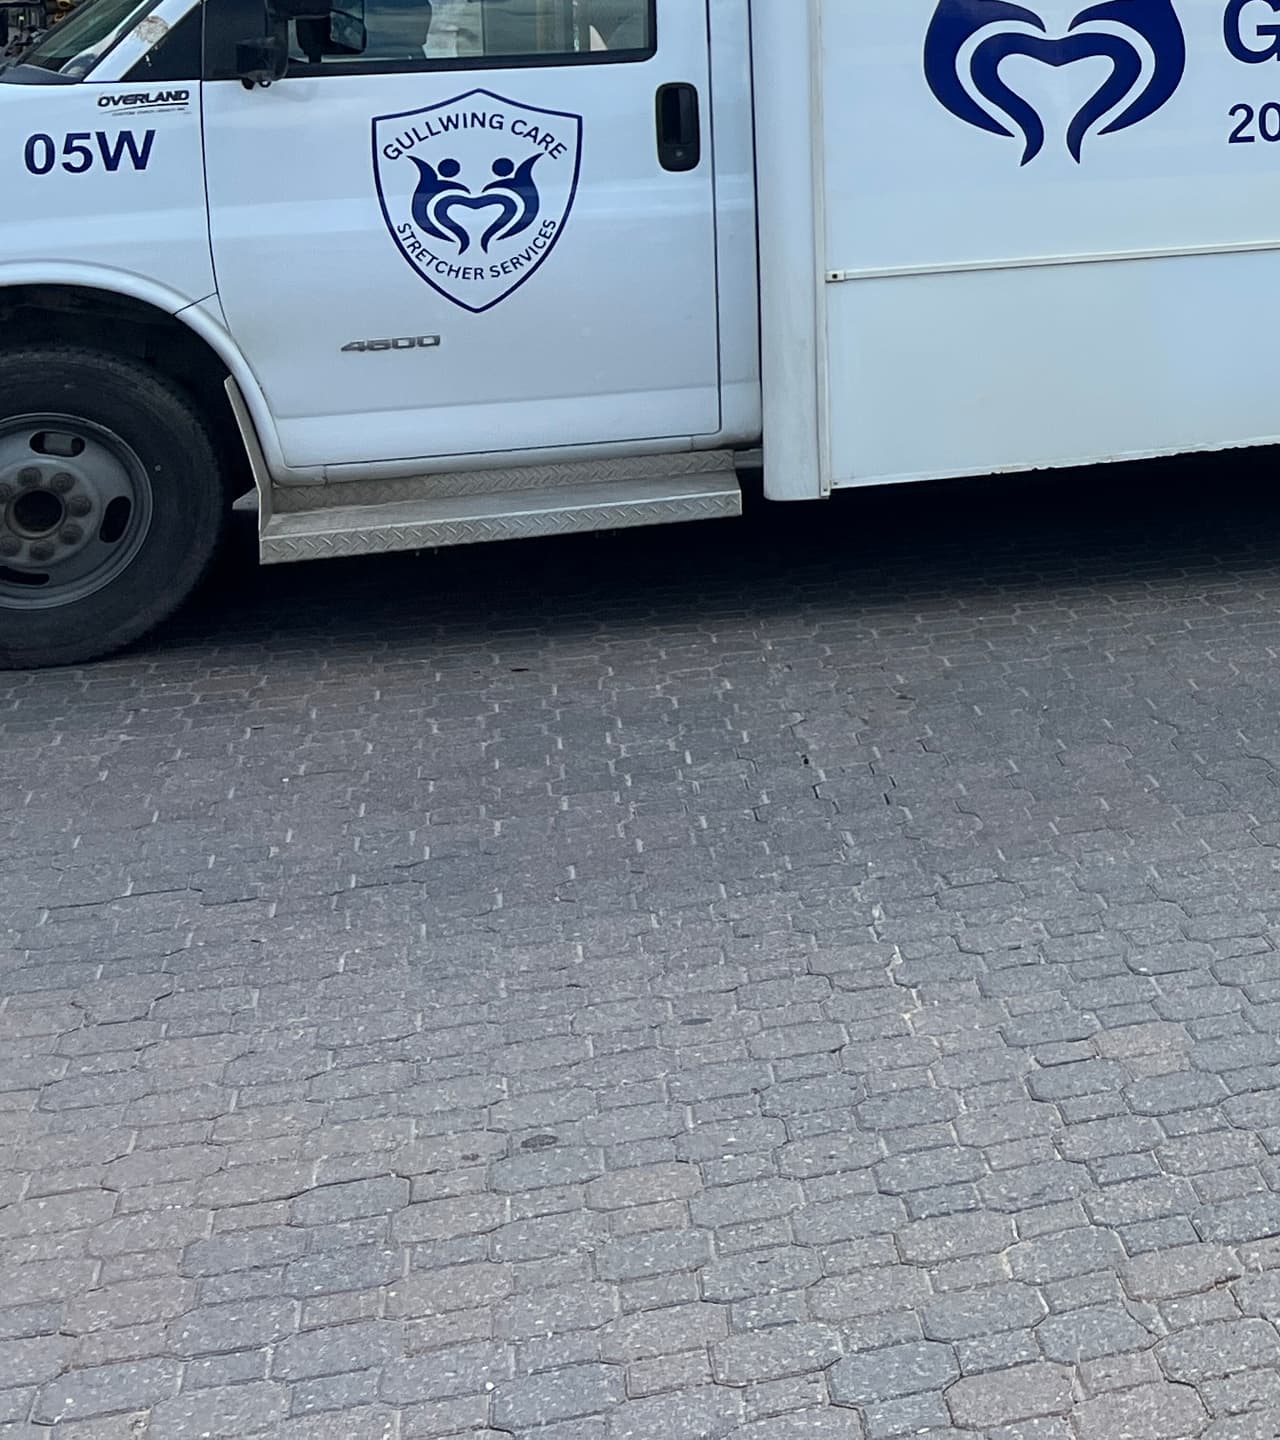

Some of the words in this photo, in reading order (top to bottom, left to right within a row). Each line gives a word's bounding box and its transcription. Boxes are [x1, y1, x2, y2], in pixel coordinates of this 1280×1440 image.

[96, 89, 191, 108] OVERLAND
[24, 129, 157, 175] 05W
[382, 111, 505, 161] GULLWING
[510, 118, 568, 160] CARE
[397, 222, 485, 280] STRETCHER
[488, 218, 557, 278] SERVICES
